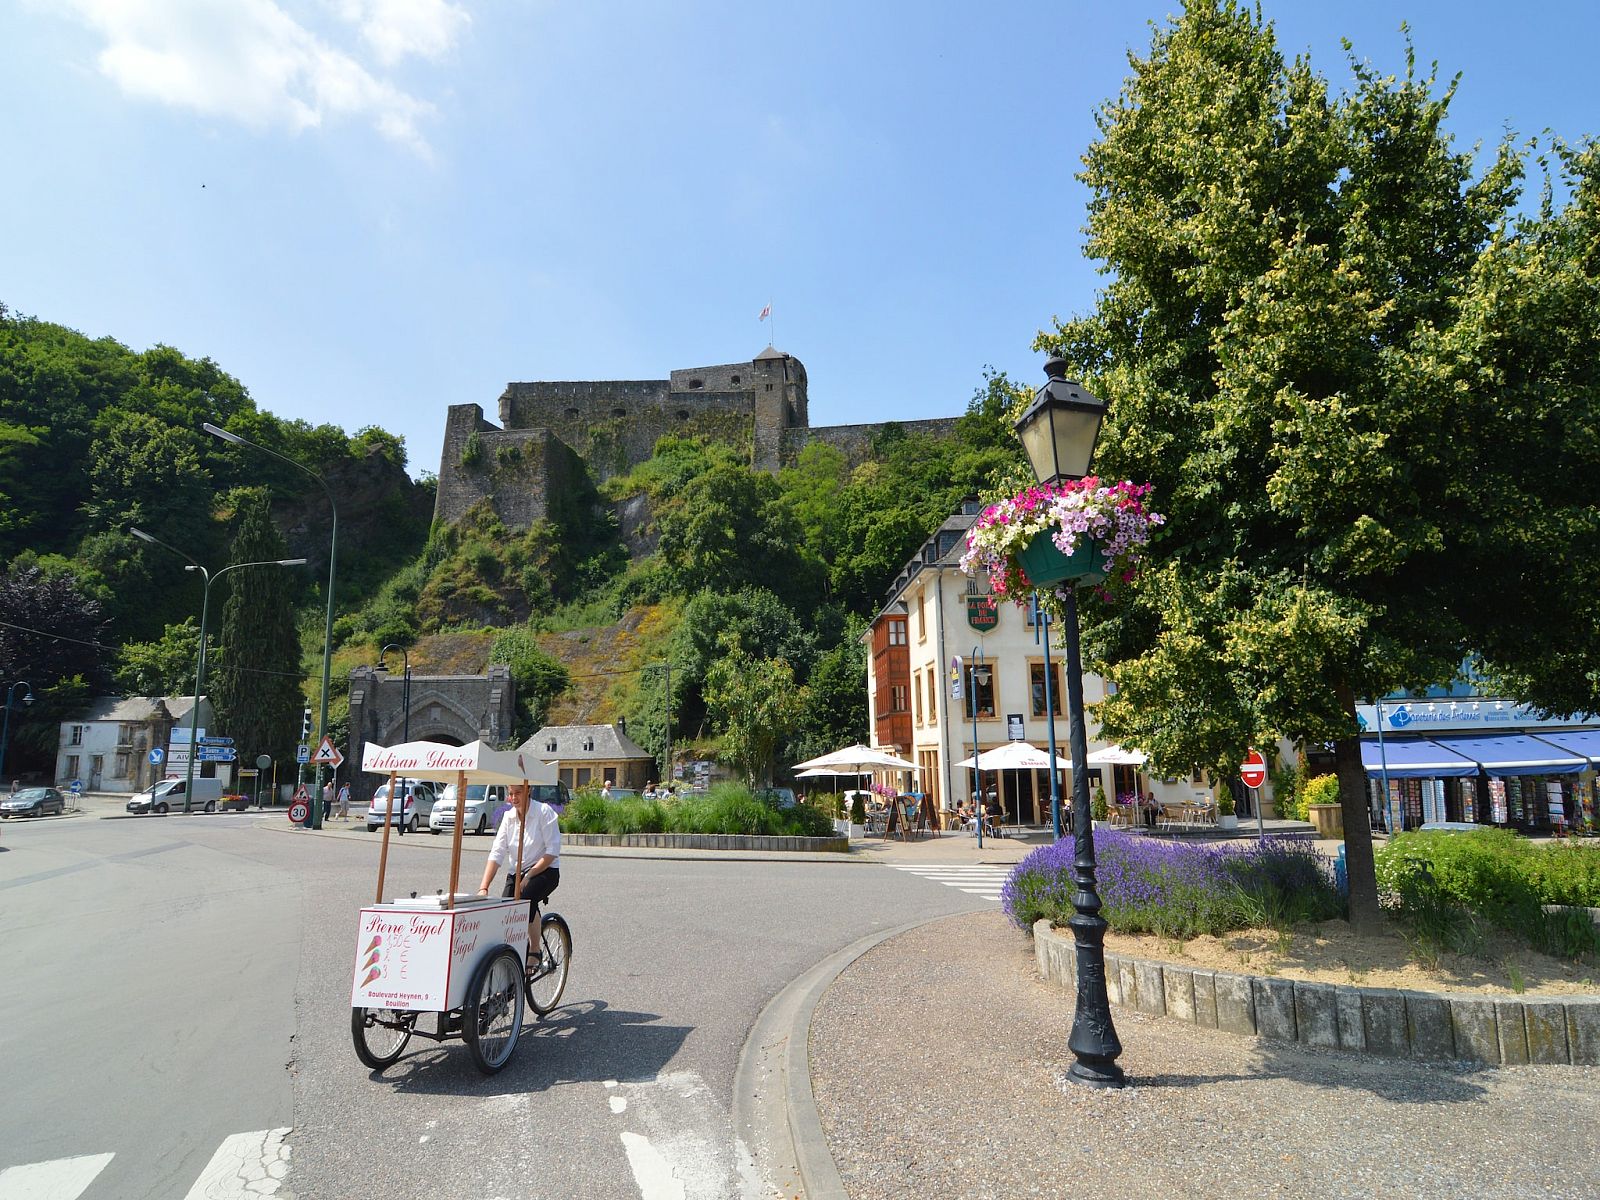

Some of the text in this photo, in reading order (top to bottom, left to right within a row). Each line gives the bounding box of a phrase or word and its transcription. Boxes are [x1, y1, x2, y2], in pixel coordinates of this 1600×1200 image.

[971, 616, 995, 624] FRANCE
[1438, 710, 1451, 721] des
[1451, 708, 1480, 721] Ardennes
[300, 747, 307, 756] P
[364, 751, 474, 768] Artisan Glacier
[292, 808, 306, 817] 30
[366, 914, 405, 933] Pierre
[502, 908, 528, 925] Artisan
[455, 914, 481, 934] Pierre
[505, 928, 527, 944] Glacier
[368, 991, 398, 999] Boulevard
